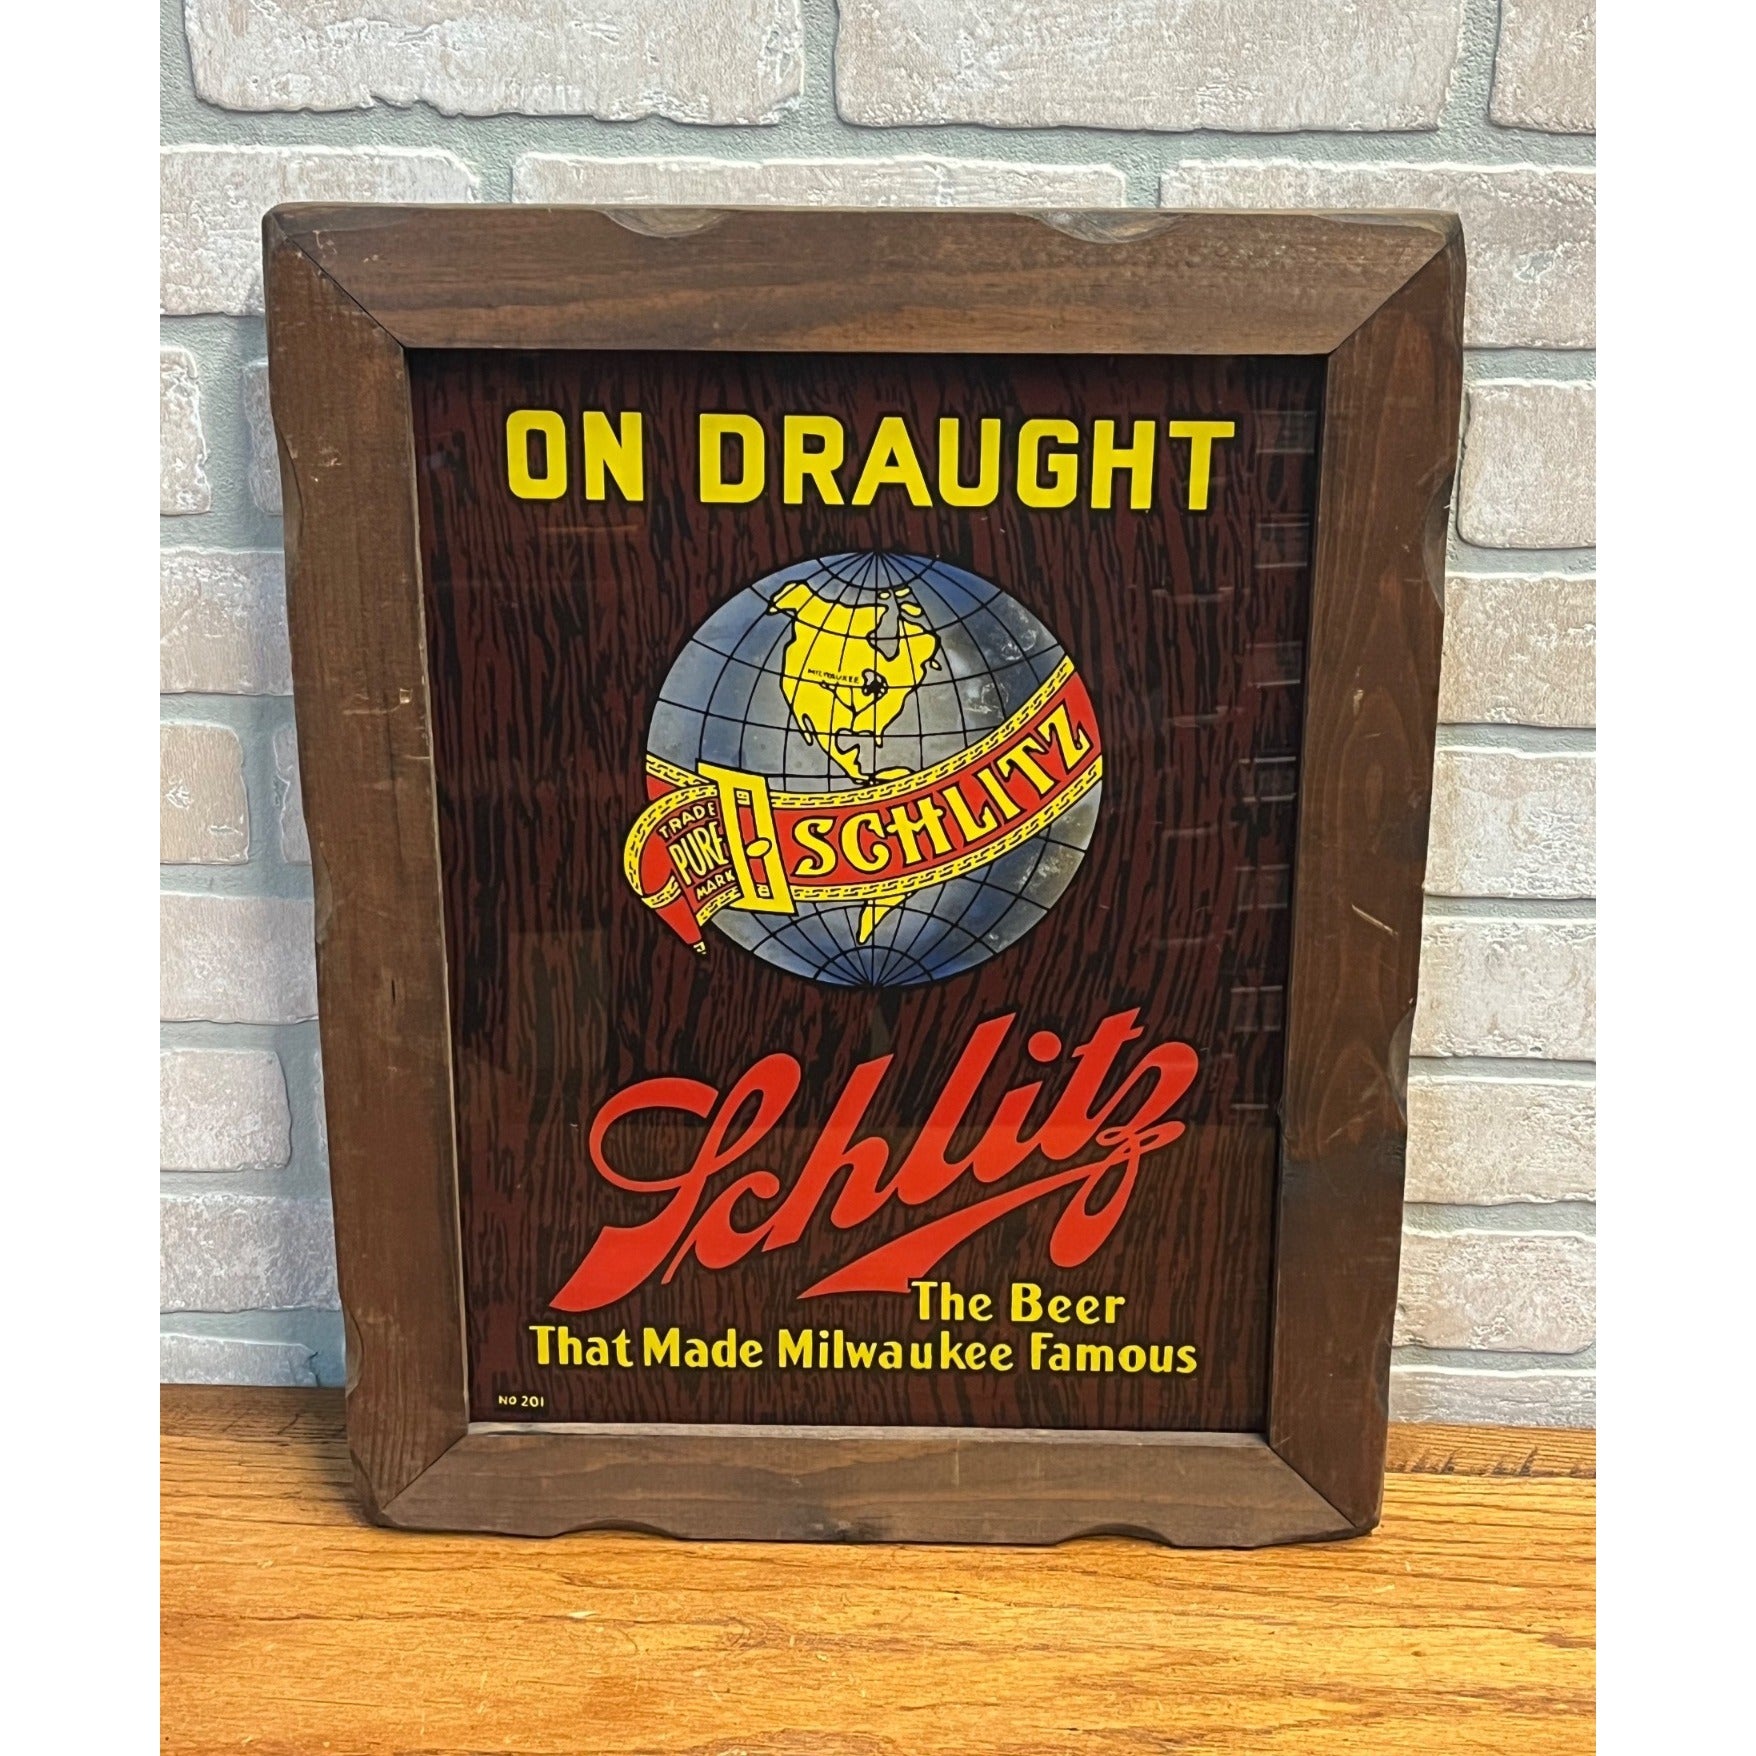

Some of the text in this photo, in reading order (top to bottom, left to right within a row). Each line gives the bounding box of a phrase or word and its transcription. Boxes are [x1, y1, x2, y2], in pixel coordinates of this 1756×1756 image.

[506, 409, 1235, 511] ON DRAUGHT
[794, 704, 1089, 875] SCHLITZ
[659, 802, 716, 839] TRADE
[668, 821, 729, 886] PURE
[696, 869, 736, 900] MARK
[548, 1007, 1198, 1312] Schlitz
[911, 1281, 1126, 1324] The Beer
[529, 1325, 1198, 1375] That Made Milwaukee Famous
[521, 1395, 544, 1407] 201
